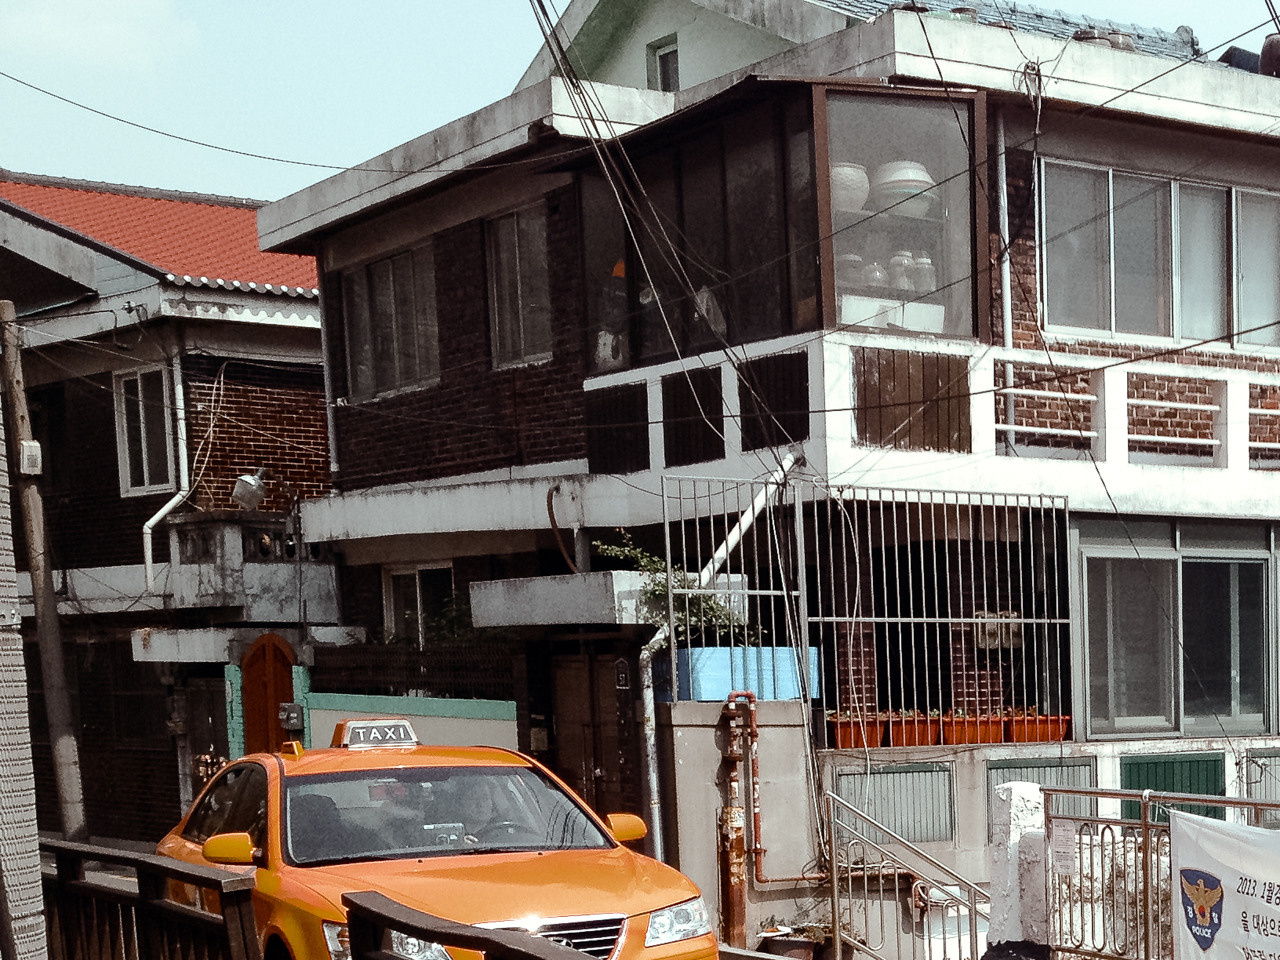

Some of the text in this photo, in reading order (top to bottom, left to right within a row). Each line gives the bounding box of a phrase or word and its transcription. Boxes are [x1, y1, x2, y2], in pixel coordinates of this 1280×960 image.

[355, 727, 405, 741] TAXI
[1236, 876, 1257, 898] 2013.
[1241, 911, 1250, 933] 을
[1191, 925, 1212, 939] POLICE
